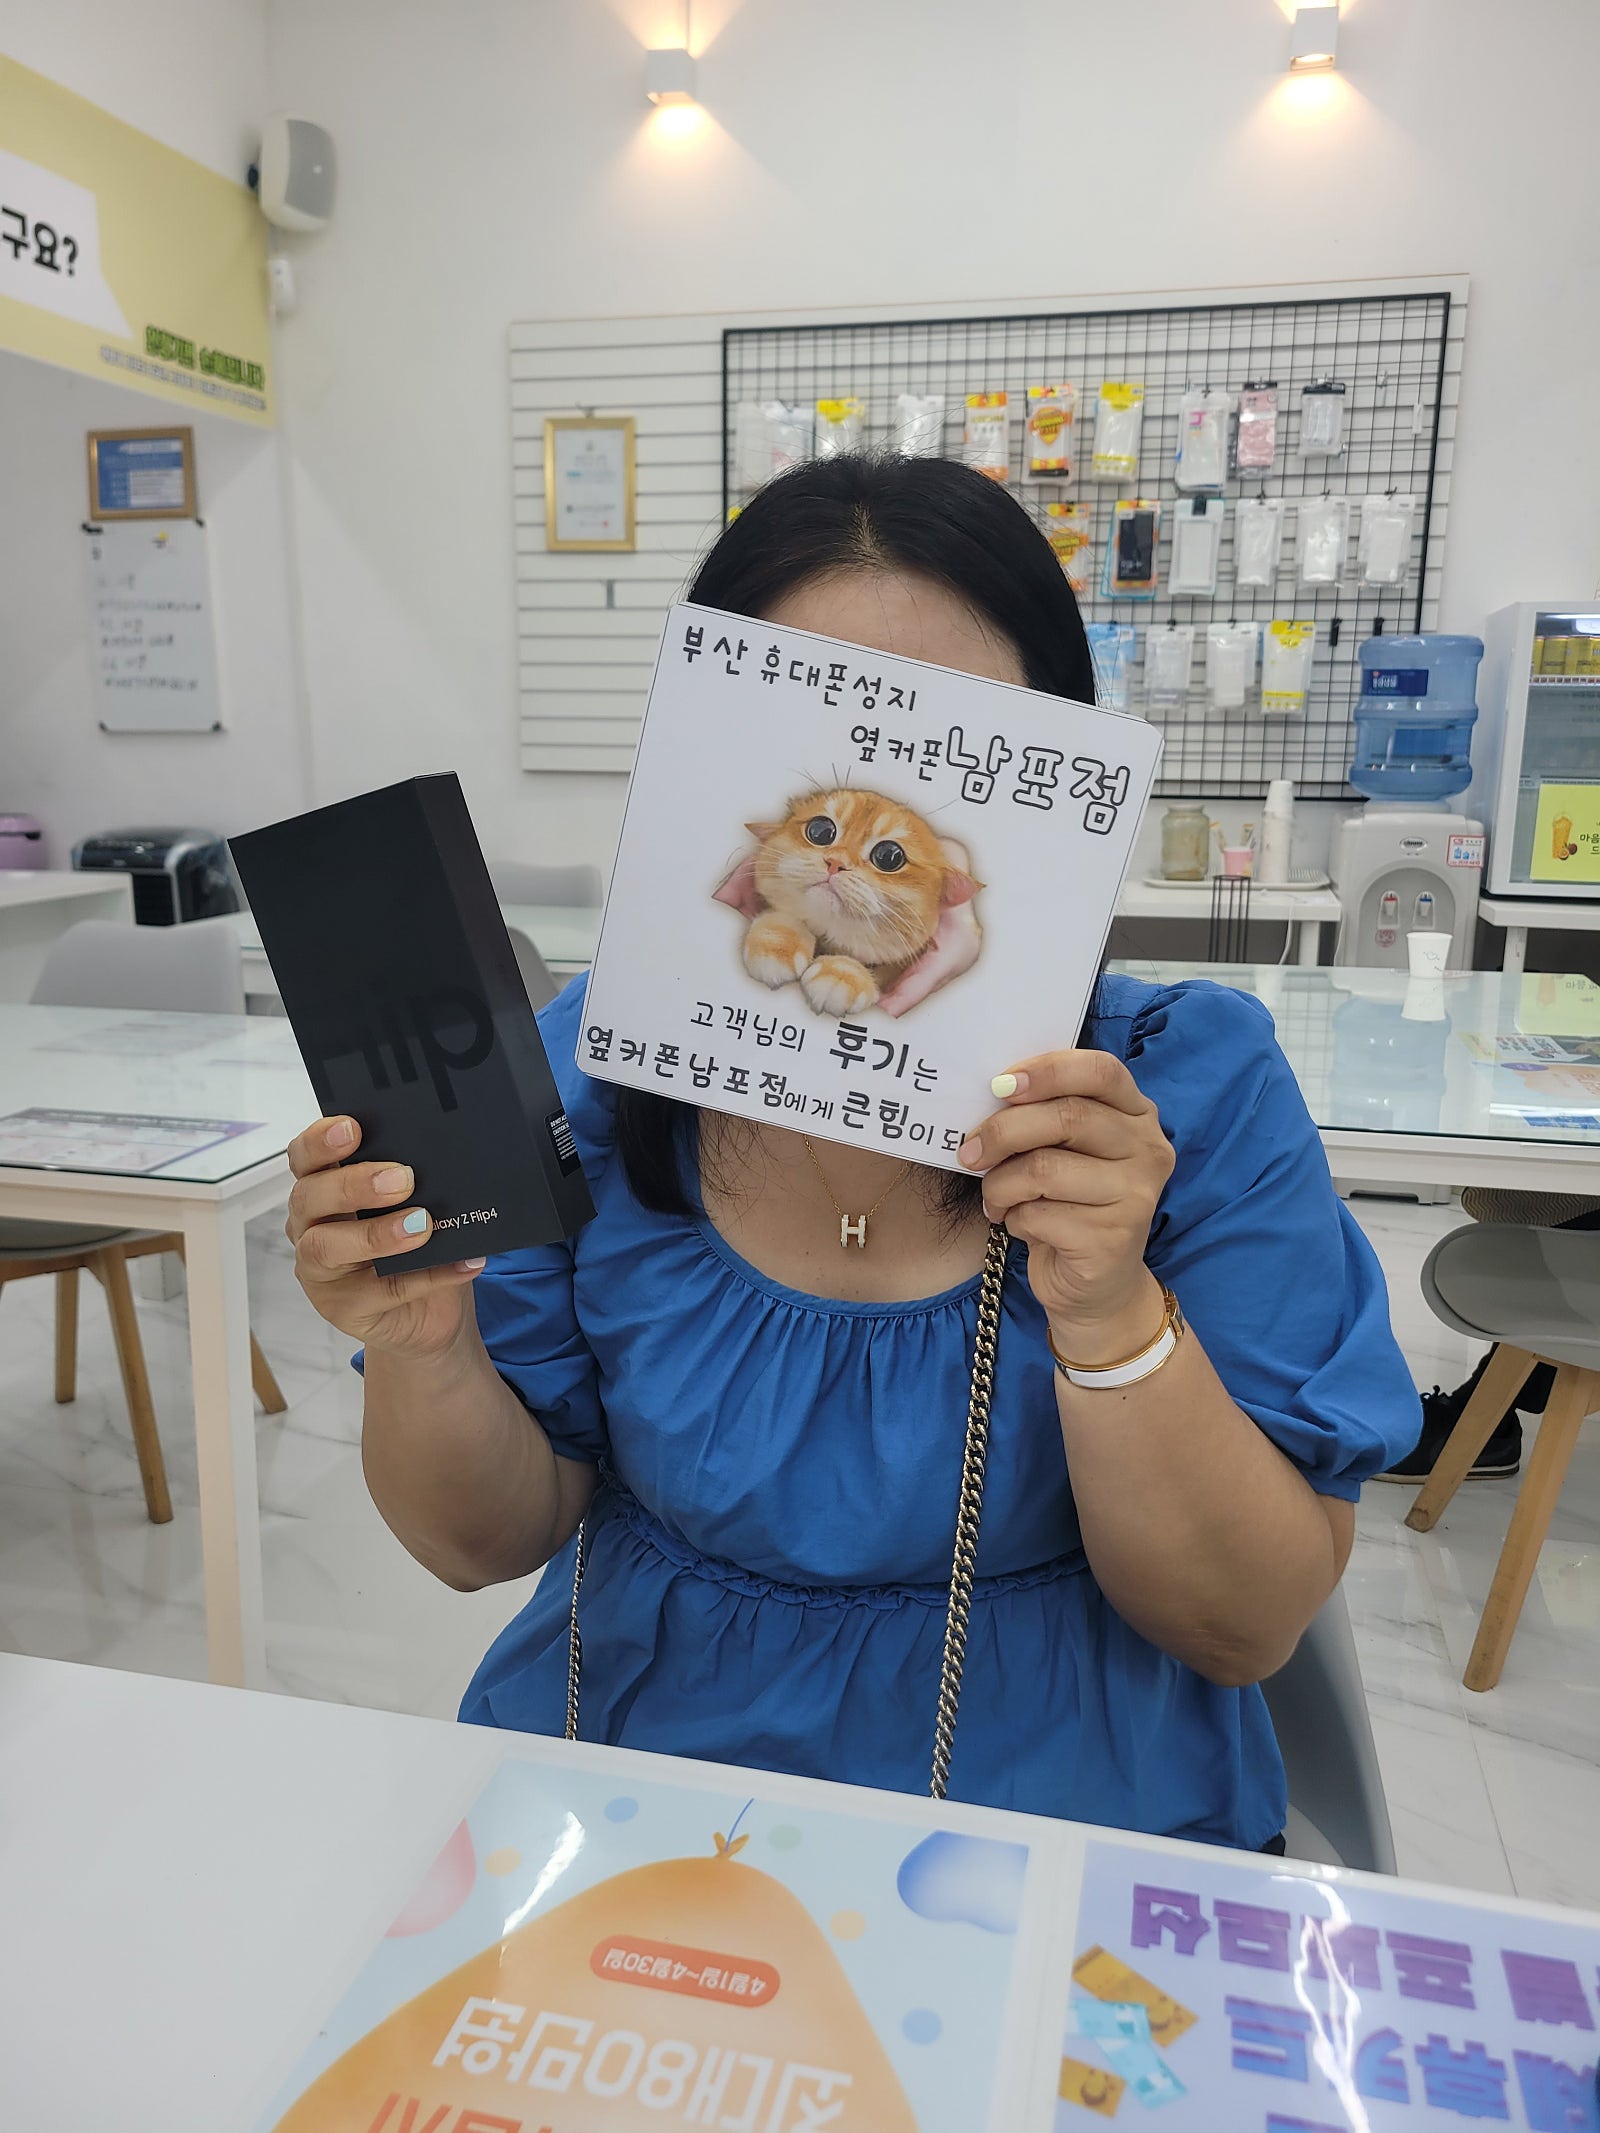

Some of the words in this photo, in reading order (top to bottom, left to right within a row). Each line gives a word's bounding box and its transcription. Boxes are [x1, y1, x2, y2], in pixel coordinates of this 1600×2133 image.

[682, 625, 748, 676] 부산
[760, 644, 916, 712] 휴대폰성지
[690, 1001, 806, 1052] 고객님의
[829, 1021, 938, 1092] 후기는
[432, 1216, 460, 1230] laxy
[461, 1213, 470, 1226] Z
[469, 1207, 498, 1225] Flip4
[603, 1949, 767, 1996] 4월1일~4월30일
[433, 1996, 853, 2133] 최대80만원
